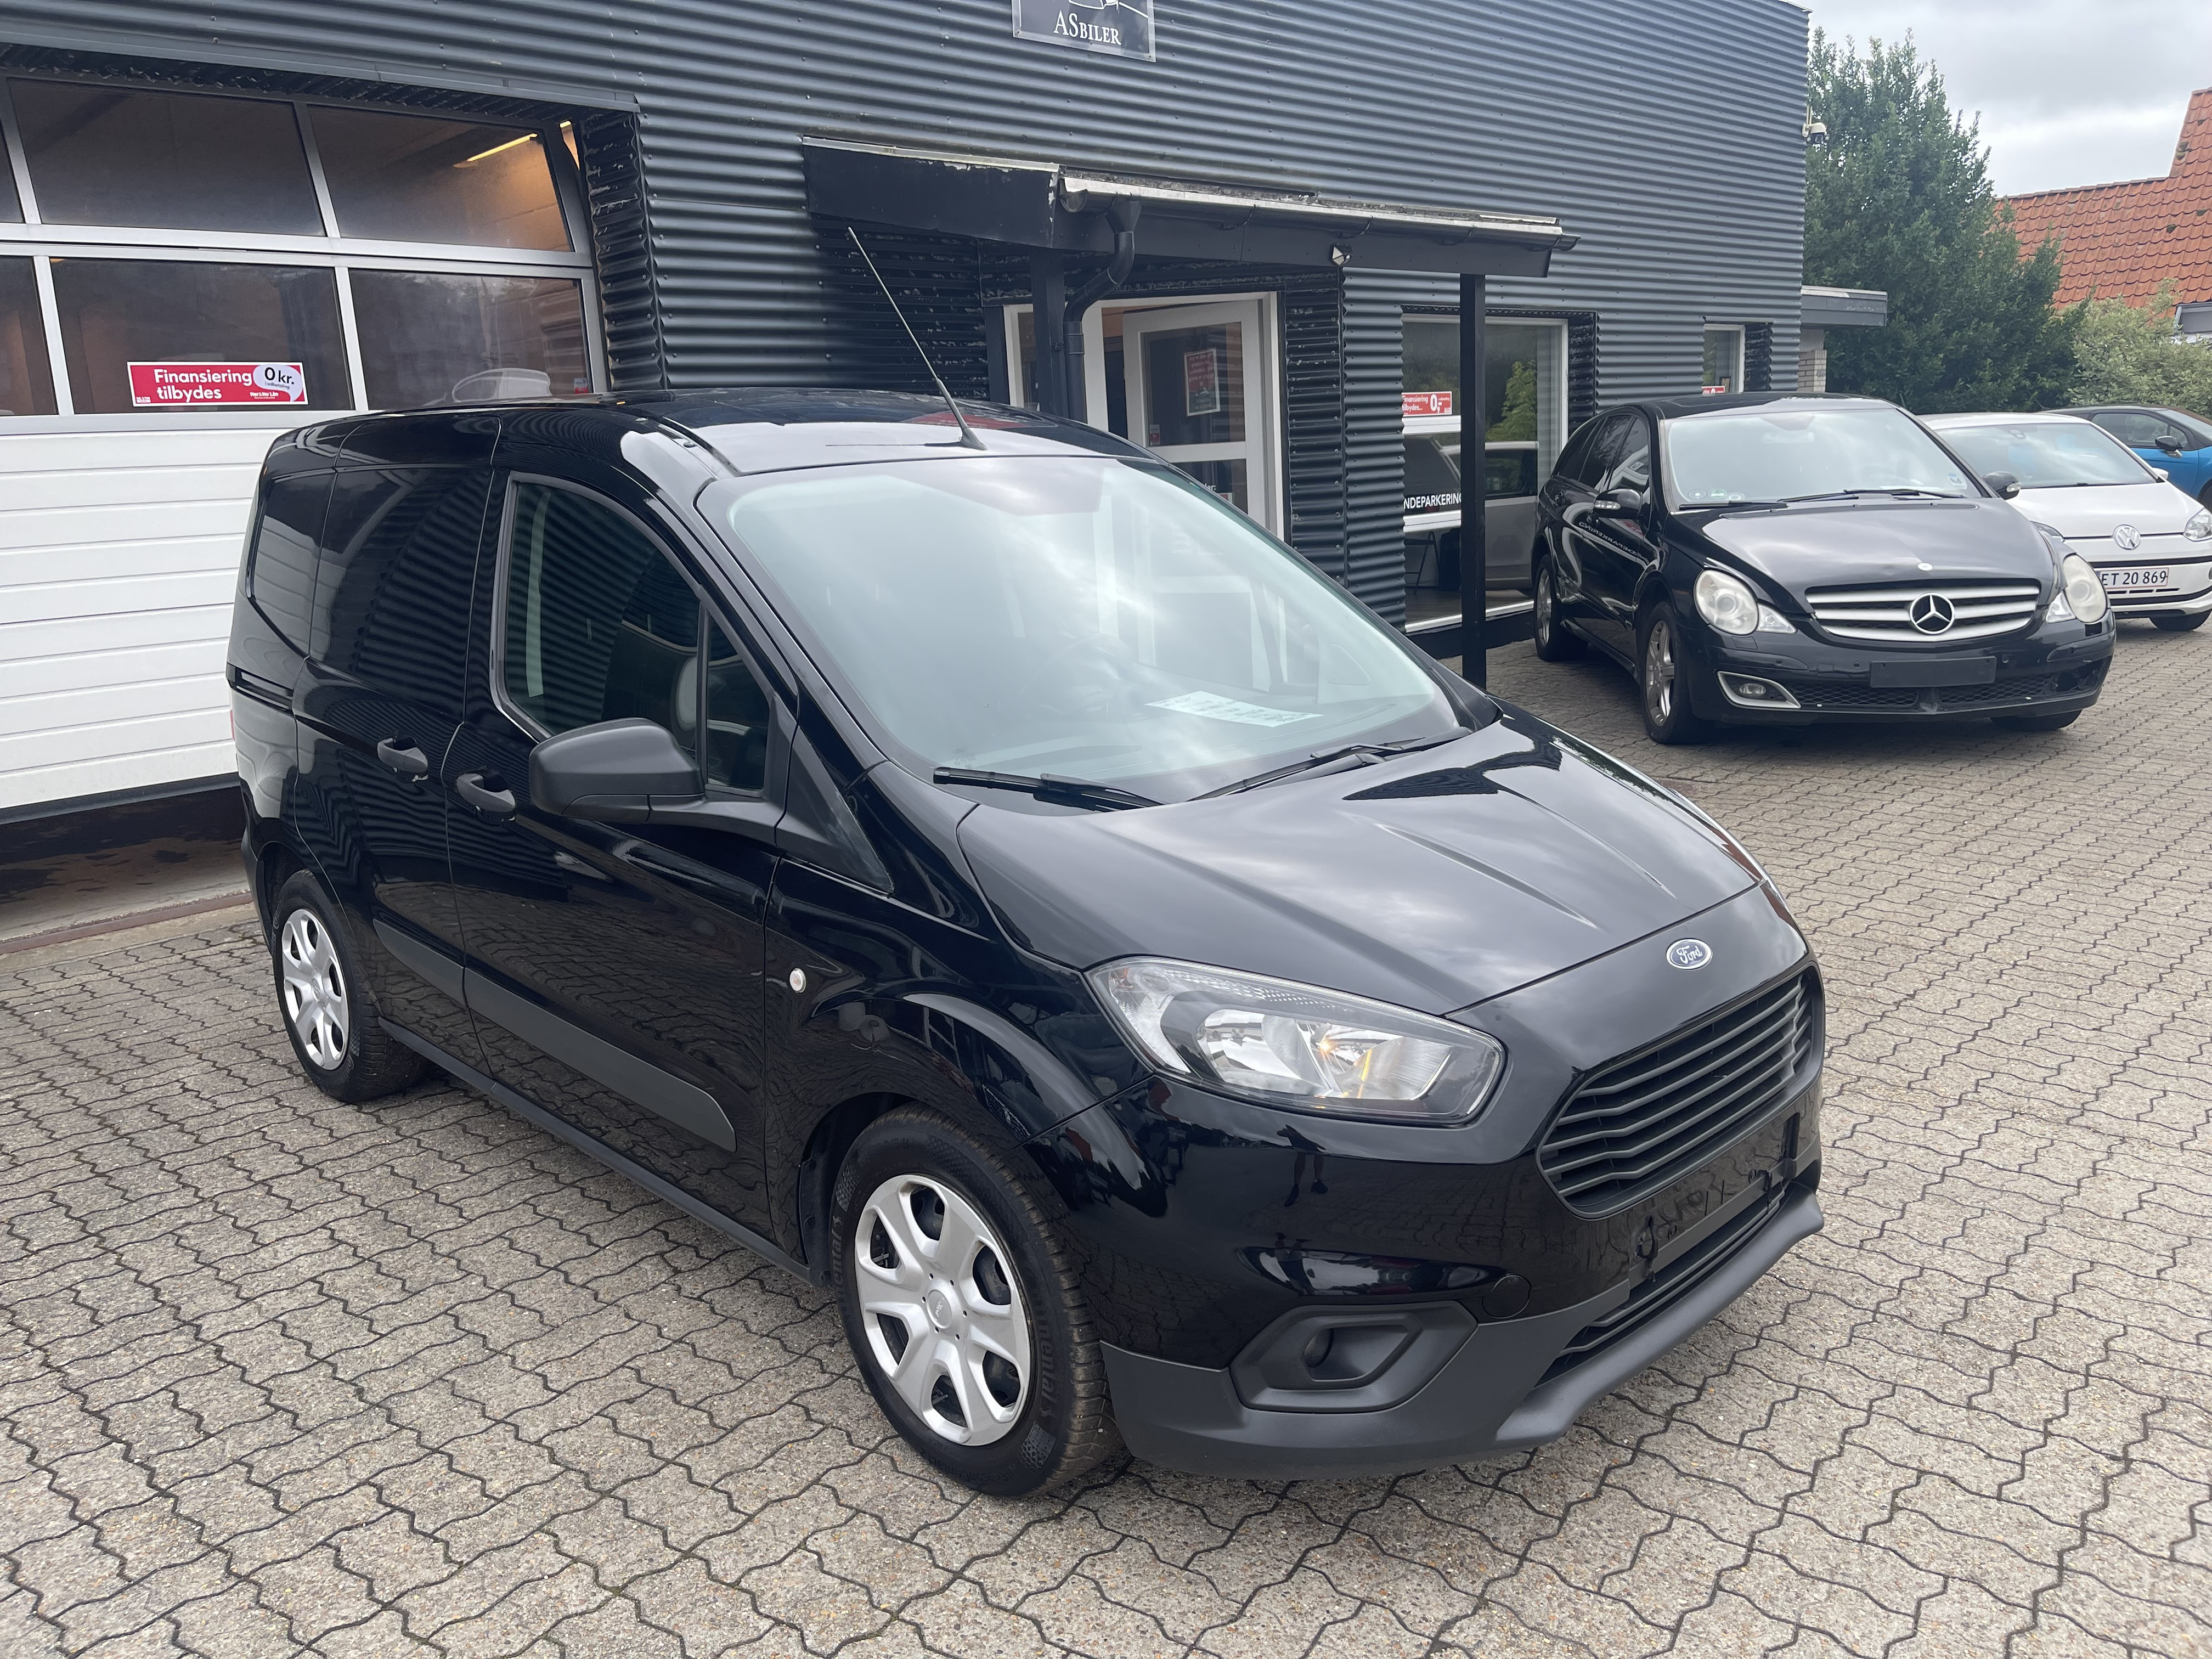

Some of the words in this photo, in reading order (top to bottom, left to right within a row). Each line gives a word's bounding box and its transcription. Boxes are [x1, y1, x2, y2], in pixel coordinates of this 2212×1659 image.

[154, 369, 252, 386] Finansiering
[265, 367, 275, 381] 0
[279, 370, 294, 385] kr.
[156, 385, 222, 402] tilbydes
[2102, 573, 2119, 586] ET
[2123, 572, 2138, 585] 20
[2142, 571, 2167, 584] 869
[1676, 945, 1703, 965] Ford
